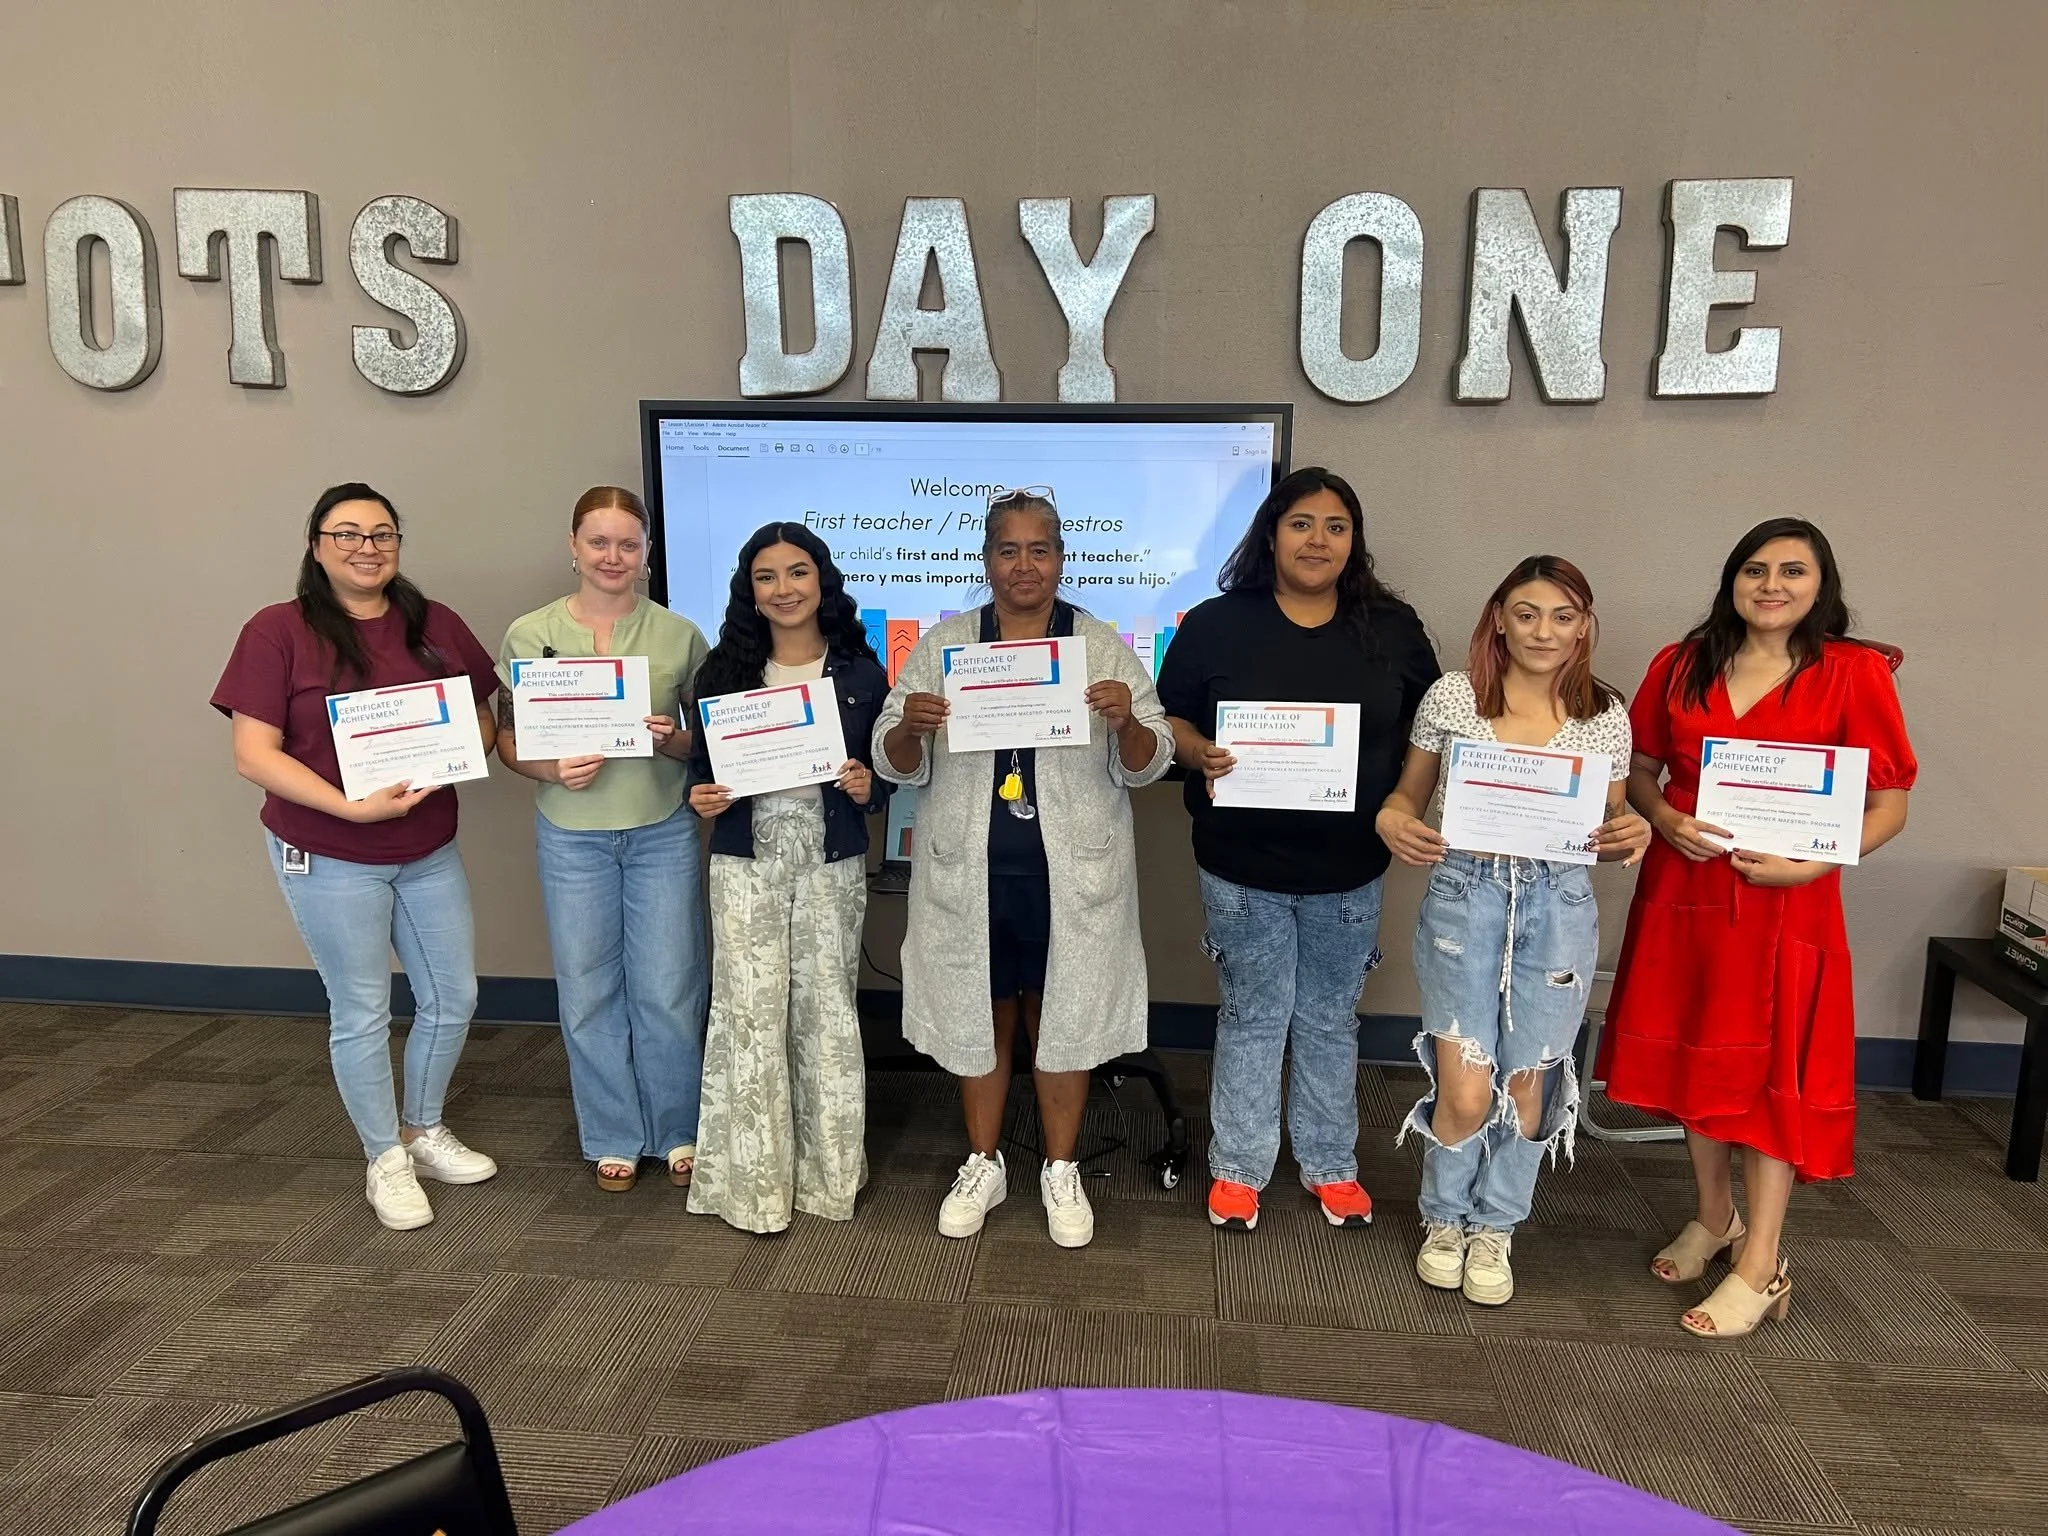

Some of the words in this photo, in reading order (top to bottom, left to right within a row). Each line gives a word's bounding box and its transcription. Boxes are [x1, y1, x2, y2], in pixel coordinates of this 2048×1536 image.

[0, 186, 468, 395] OTS
[728, 192, 1157, 403] DAY
[1299, 176, 1796, 404] ONE
[717, 444, 750, 452] Document
[803, 511, 846, 529] First
[853, 511, 933, 530] teacher
[938, 511, 952, 535] /
[896, 547, 926, 561] first
[931, 547, 959, 561] and
[964, 551, 984, 561] mo
[879, 573, 888, 586] y
[891, 573, 922, 583] mas
[1078, 575, 1113, 588] para
[1118, 575, 1134, 584] su
[953, 656, 1004, 666] CERTIFICATE
[521, 671, 570, 679] CERTIFICATE
[953, 665, 1012, 675] ACHIEVEMENT
[339, 701, 391, 715] CERTIFICATE
[711, 704, 759, 717] CERTIFICATE
[340, 709, 400, 724] ACHIEVEMENT
[712, 712, 767, 725] ACHIEVEMENT
[1462, 751, 1528, 765] CERTIFICATE
[1532, 758, 1545, 766] OF
[1713, 752, 1770, 763] CERTIFICATE
[1462, 760, 1537, 775] PARTICIPATION
[1712, 762, 1778, 773] ACHIEVEMENT
[2005, 946, 2038, 972] COMET
